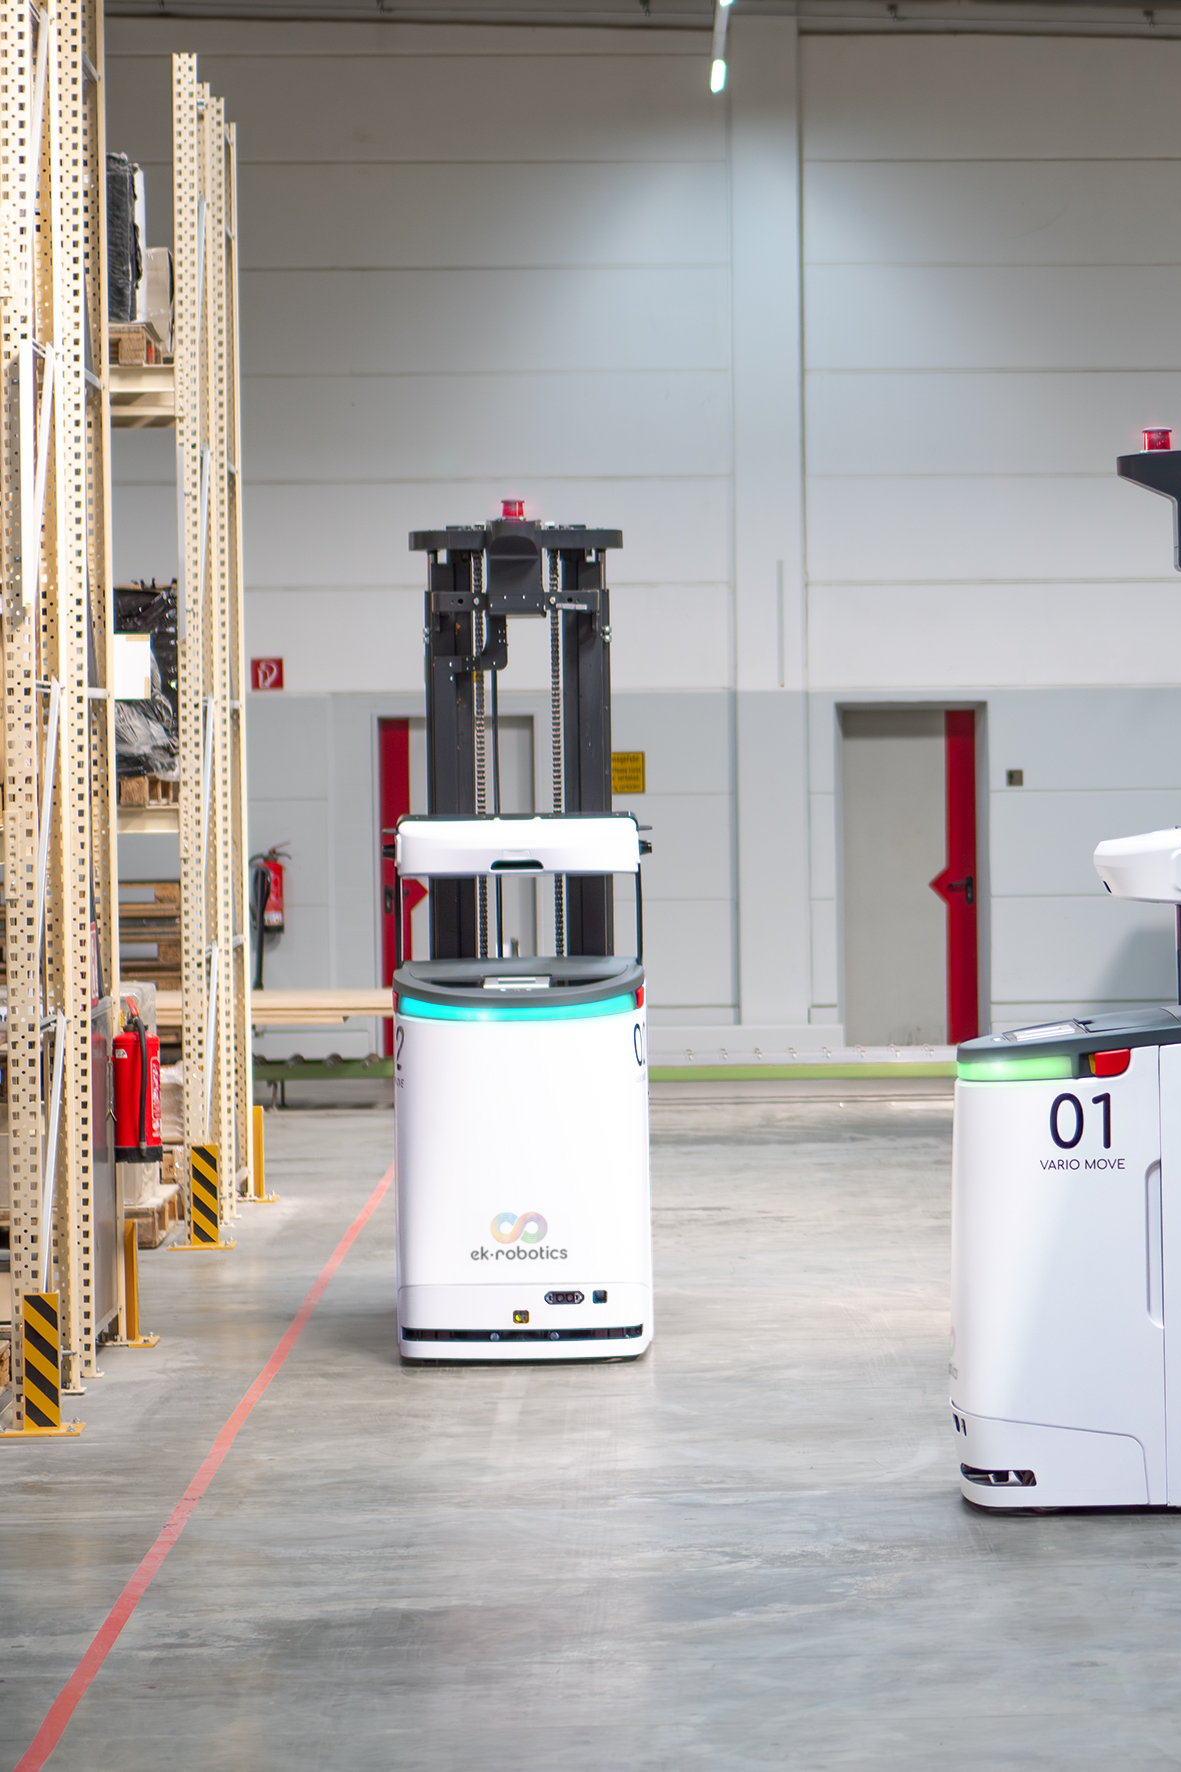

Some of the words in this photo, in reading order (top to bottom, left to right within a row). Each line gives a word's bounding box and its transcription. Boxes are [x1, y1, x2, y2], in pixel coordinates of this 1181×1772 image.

[1049, 1092, 1112, 1150] 01
[1039, 1158, 1080, 1170] VARIO
[1084, 1158, 1126, 1170] MOVE
